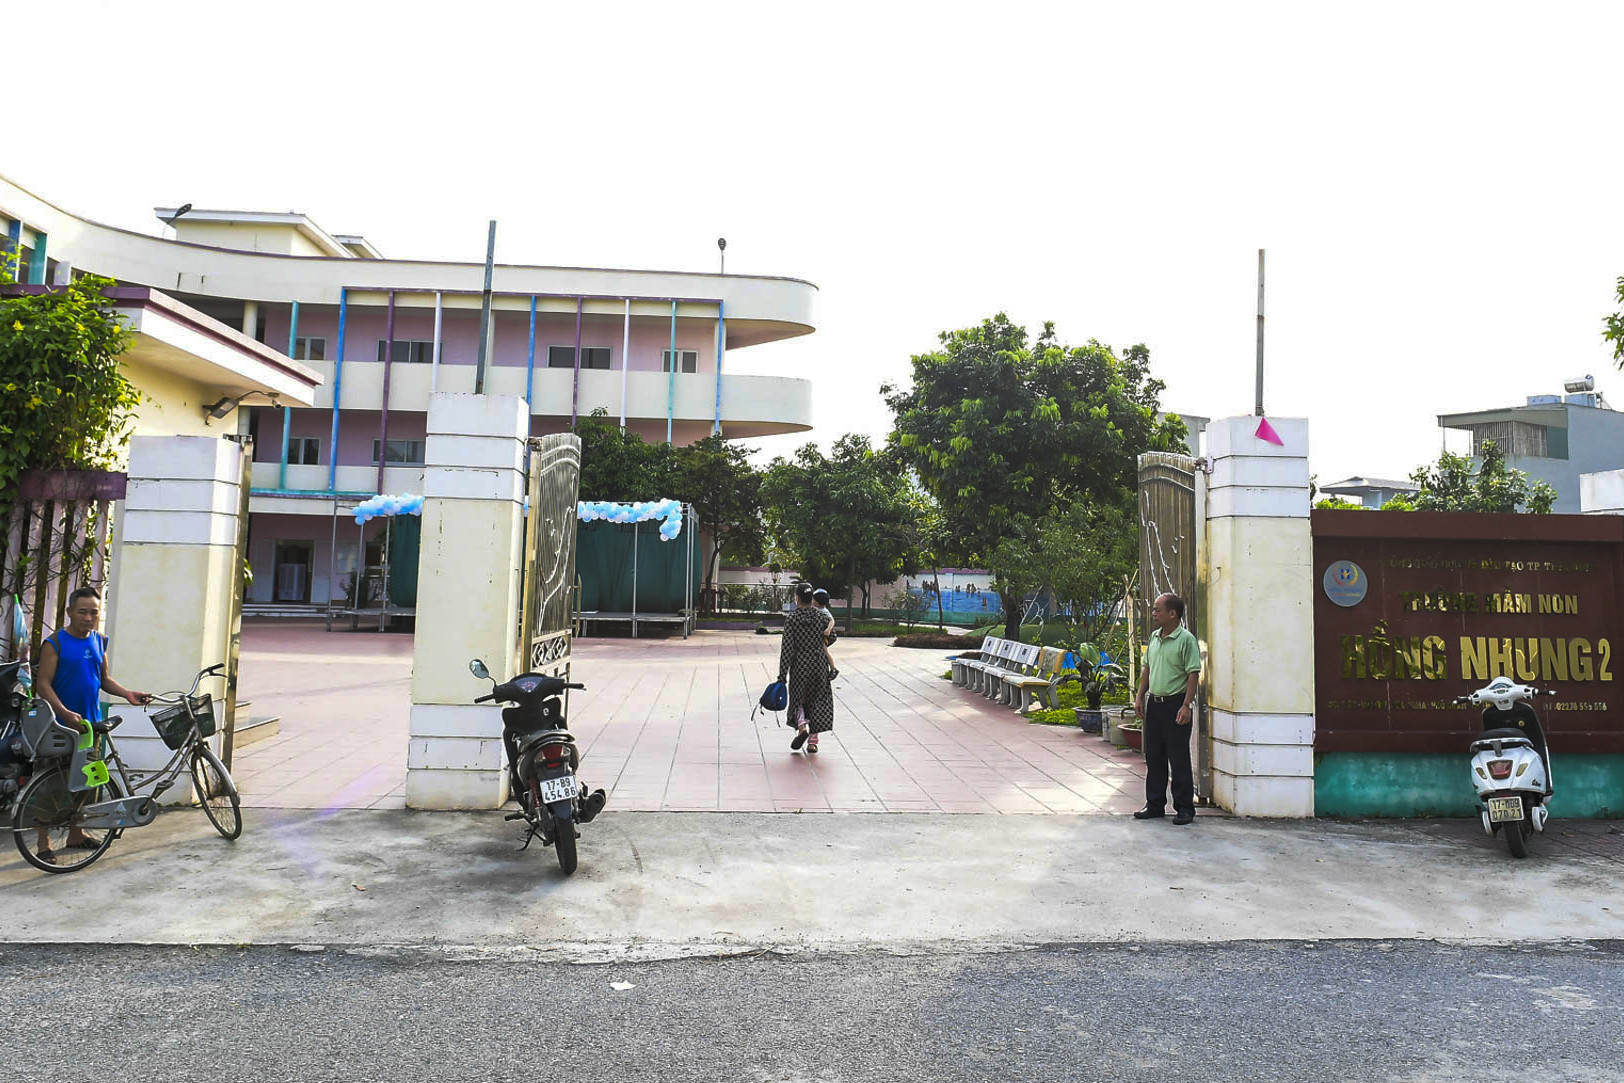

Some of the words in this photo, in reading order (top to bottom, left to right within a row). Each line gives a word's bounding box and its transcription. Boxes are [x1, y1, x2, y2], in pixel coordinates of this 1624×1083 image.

[1538, 593, 1578, 615] NON
[1340, 618, 1448, 680] HỒNG
[1459, 635, 1594, 681] NHUNG
[1597, 637, 1613, 681] 2
